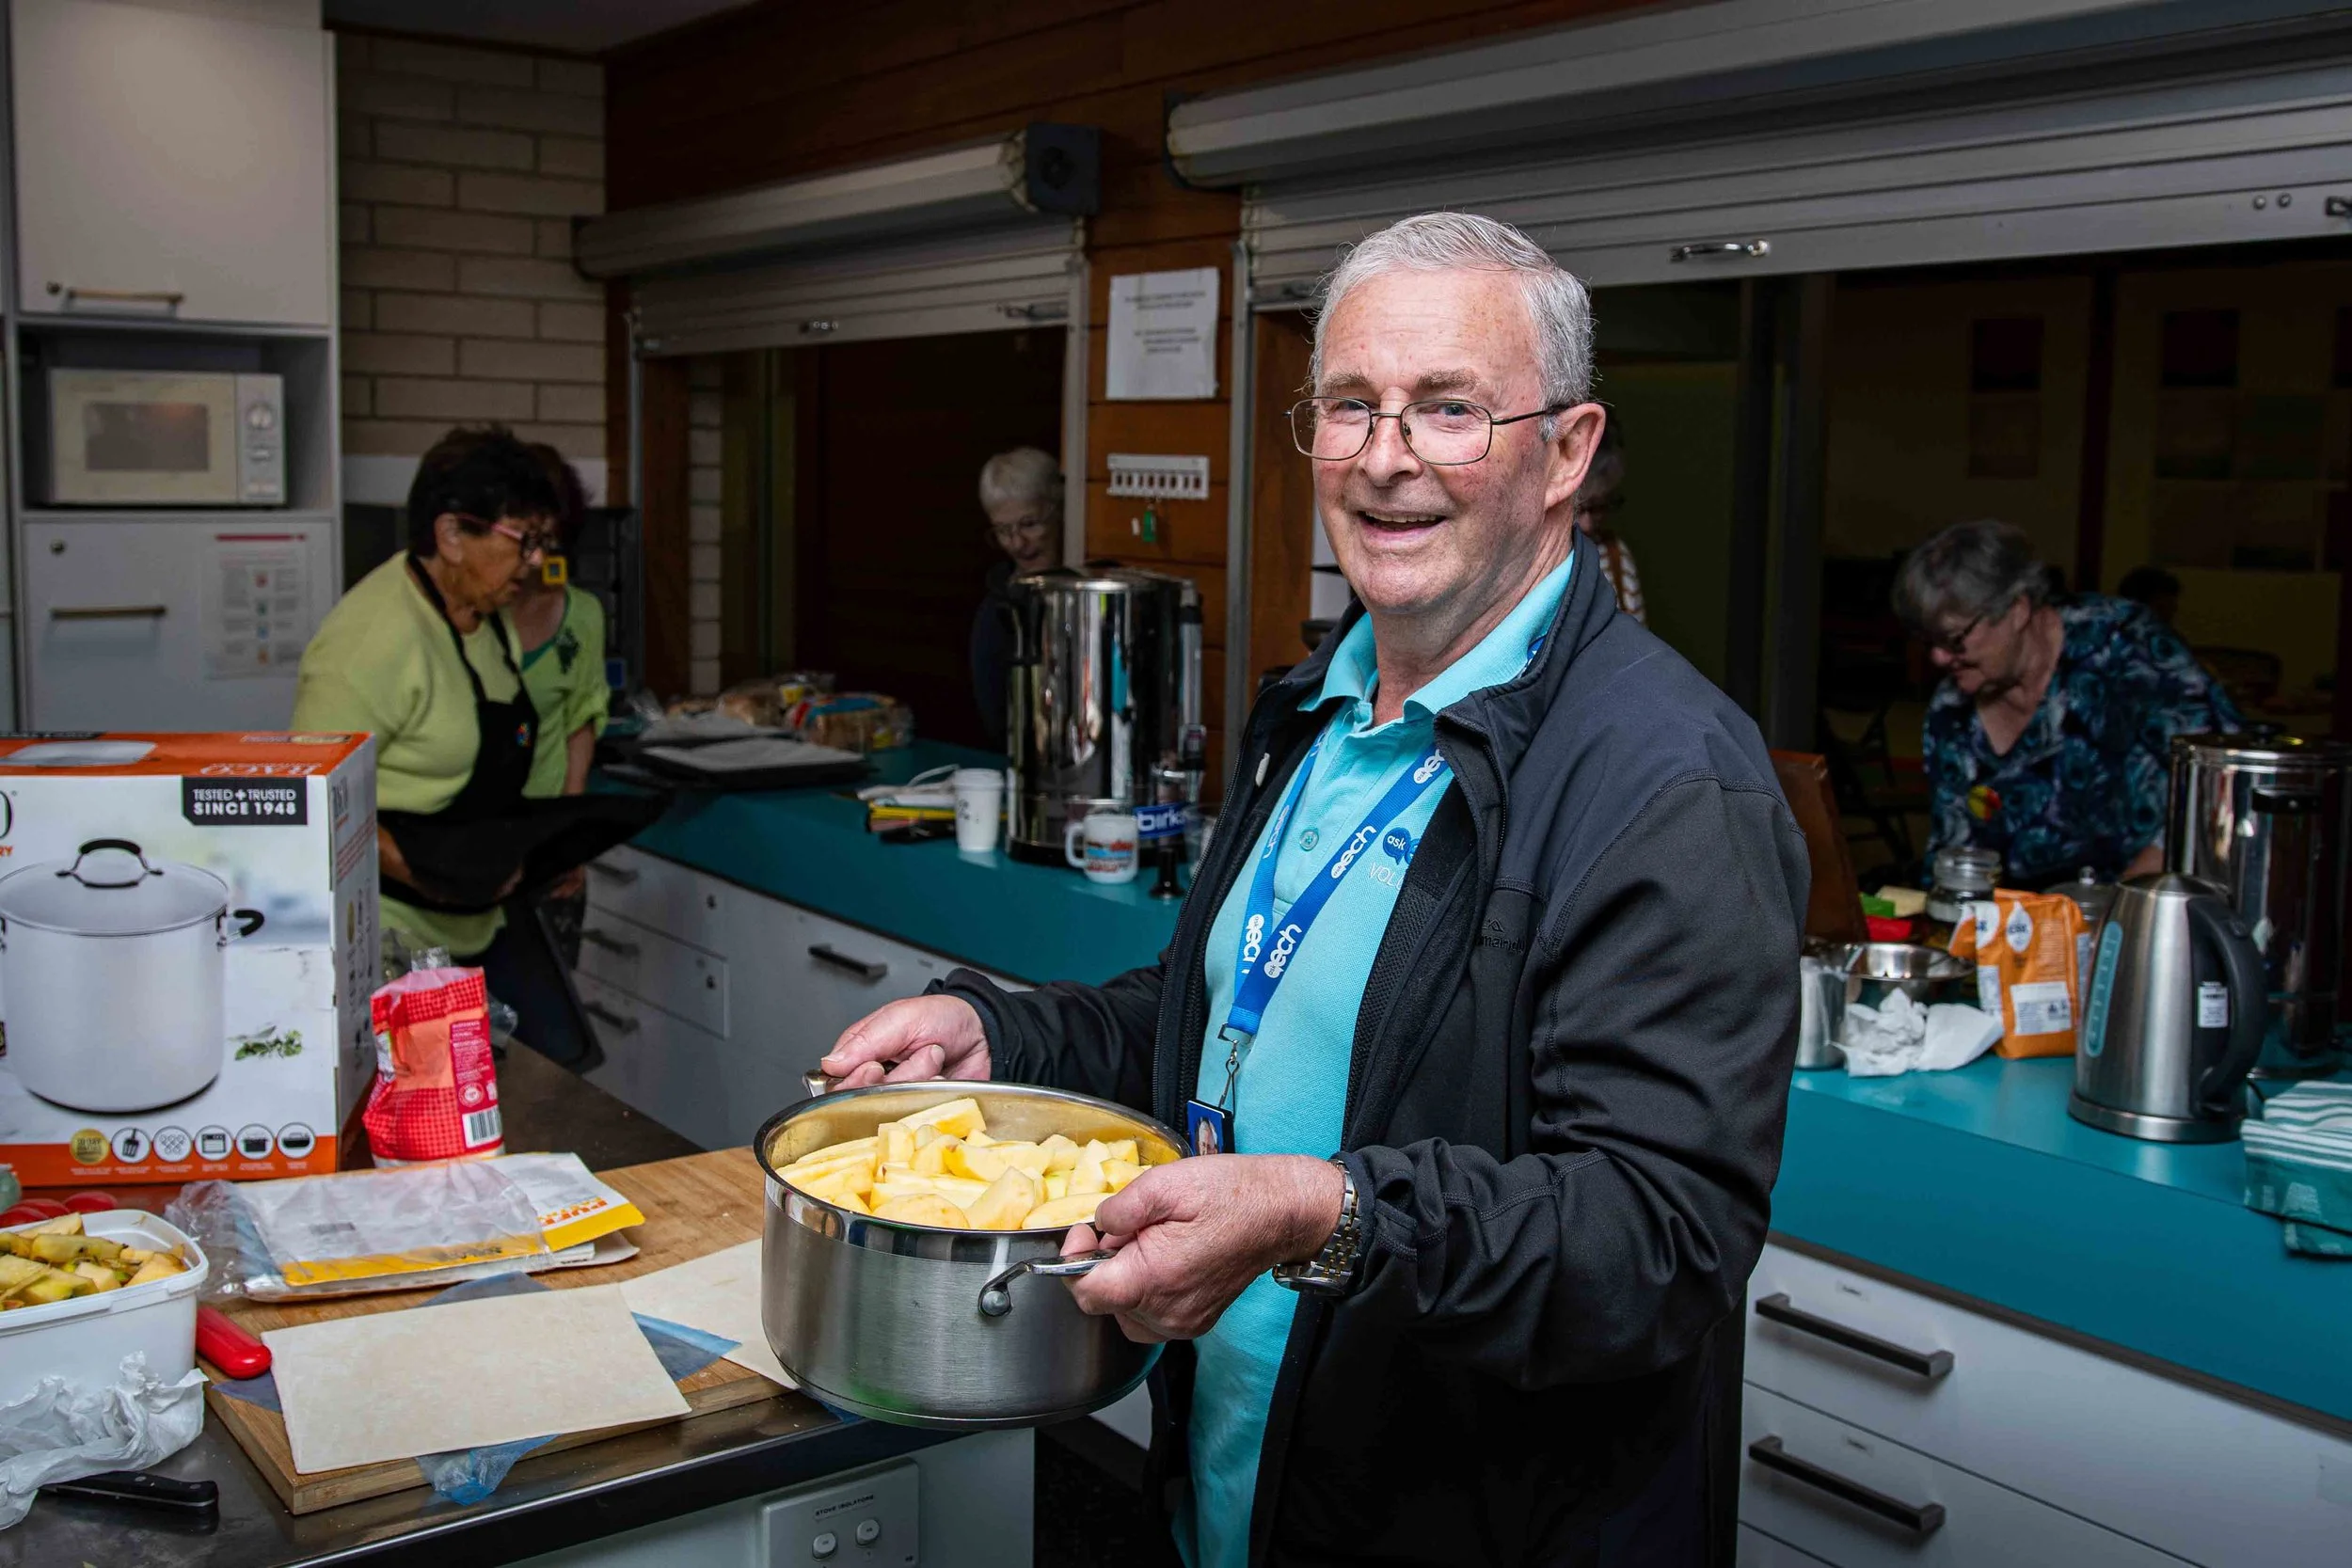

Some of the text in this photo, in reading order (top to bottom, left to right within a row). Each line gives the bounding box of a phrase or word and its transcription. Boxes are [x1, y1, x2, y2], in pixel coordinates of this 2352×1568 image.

[193, 789, 232, 800] TESTED
[246, 789, 296, 800] TRUSTED
[193, 801, 296, 816] SINCE 1948
[1387, 834, 1406, 850] ask
